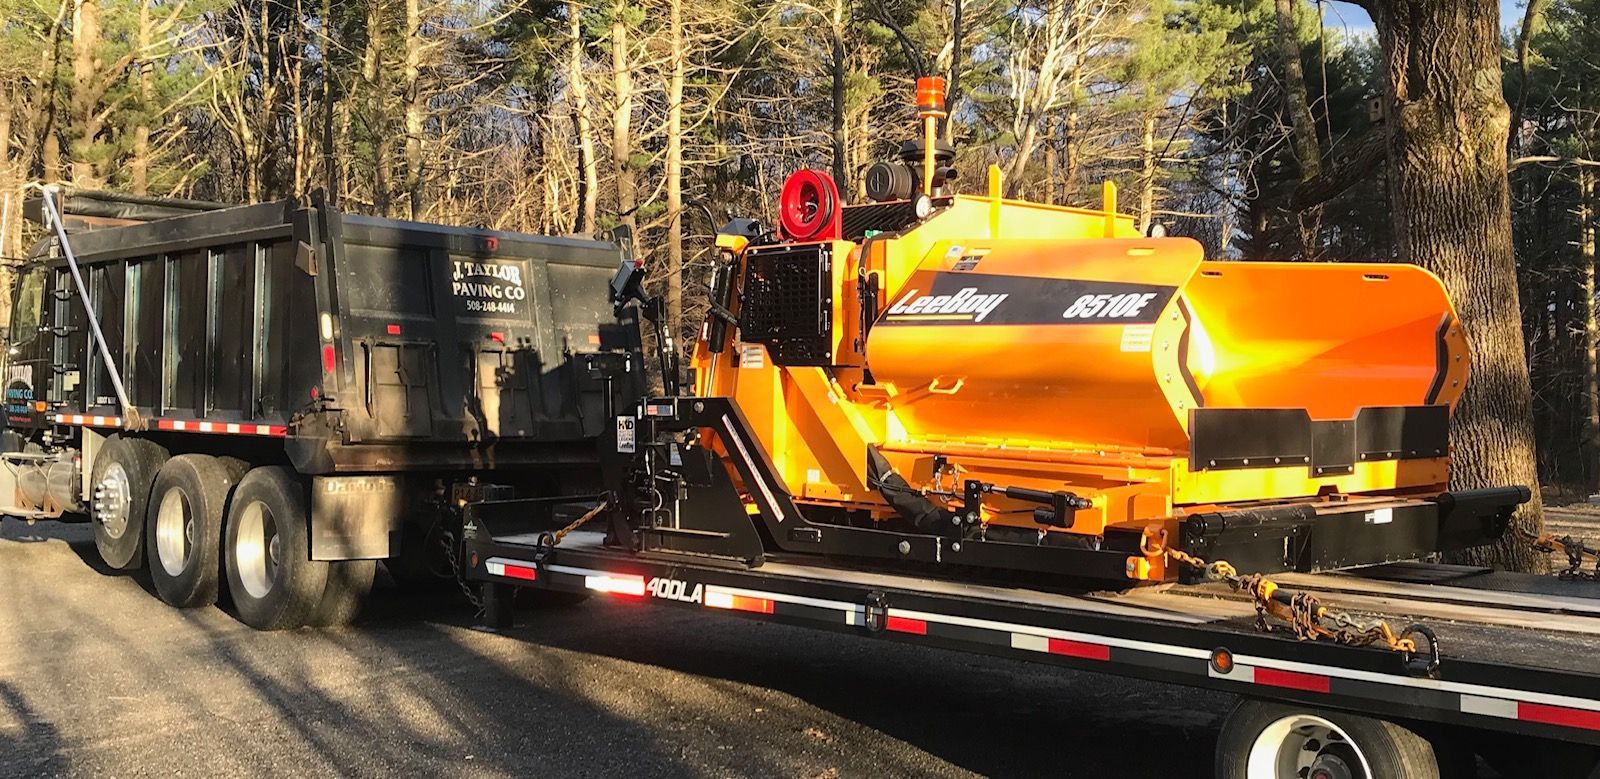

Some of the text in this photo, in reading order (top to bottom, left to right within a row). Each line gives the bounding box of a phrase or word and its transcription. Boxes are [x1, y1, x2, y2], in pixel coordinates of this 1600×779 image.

[453, 261, 522, 287] J. TAYLOR
[452, 282, 525, 300] PAVING CO
[466, 299, 515, 313] 508-248-4414
[888, 287, 1158, 323] LeeBoy 8510E
[646, 577, 703, 604] 40DLA
